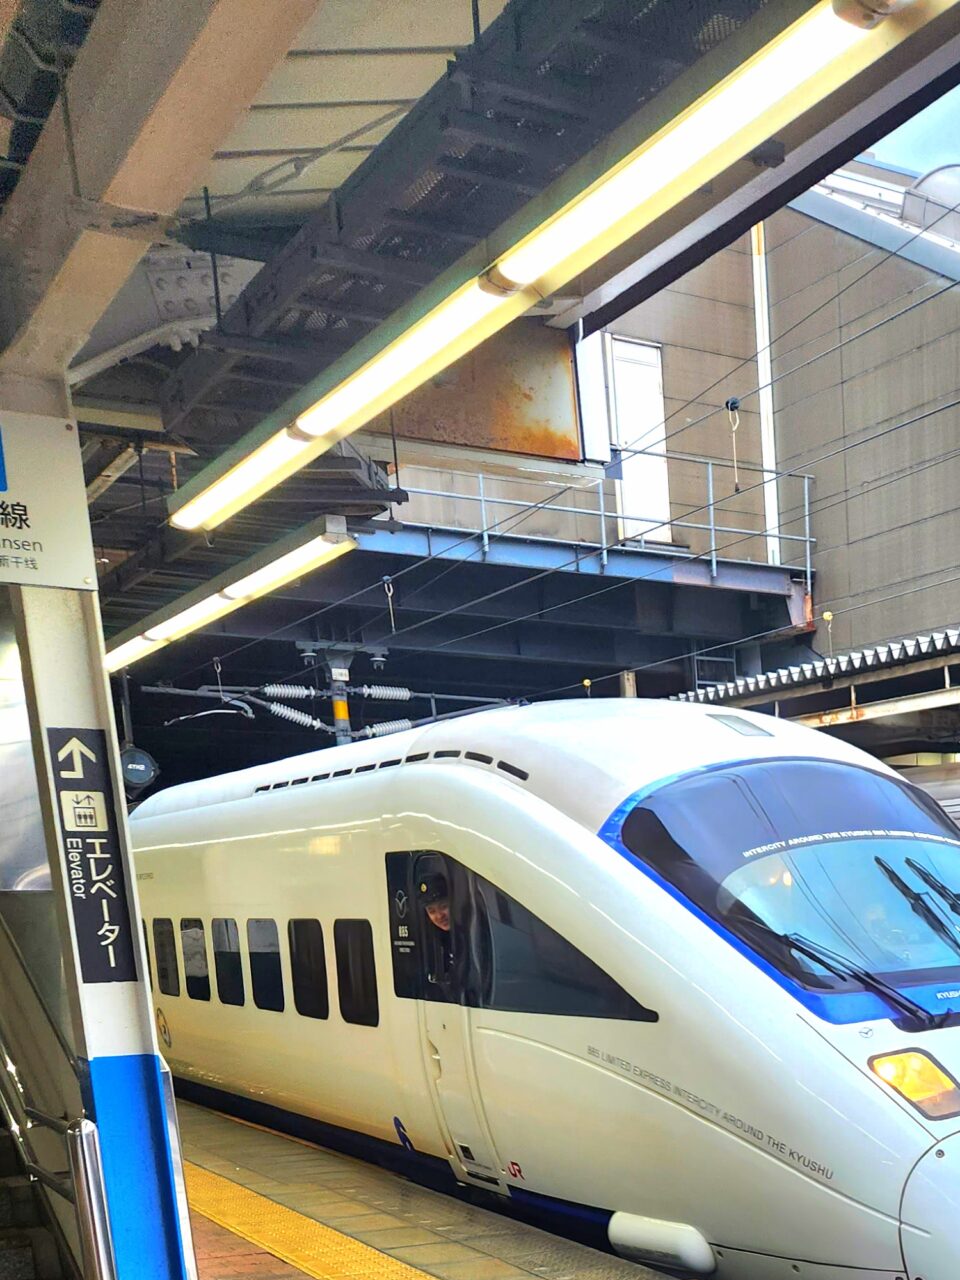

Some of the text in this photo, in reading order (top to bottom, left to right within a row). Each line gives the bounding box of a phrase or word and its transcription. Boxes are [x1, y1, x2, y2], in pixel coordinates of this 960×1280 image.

[0, 538, 43, 552] nsen
[66, 838, 87, 899] Elevator
[743, 841, 786, 858] INTERCITY
[86, 838, 120, 967] エレベーター
[632, 1065, 672, 1092] EXPRESS
[722, 1112, 764, 1141] AROUND
[766, 1134, 787, 1154] THE
[788, 1149, 834, 1180] KYUSHU
